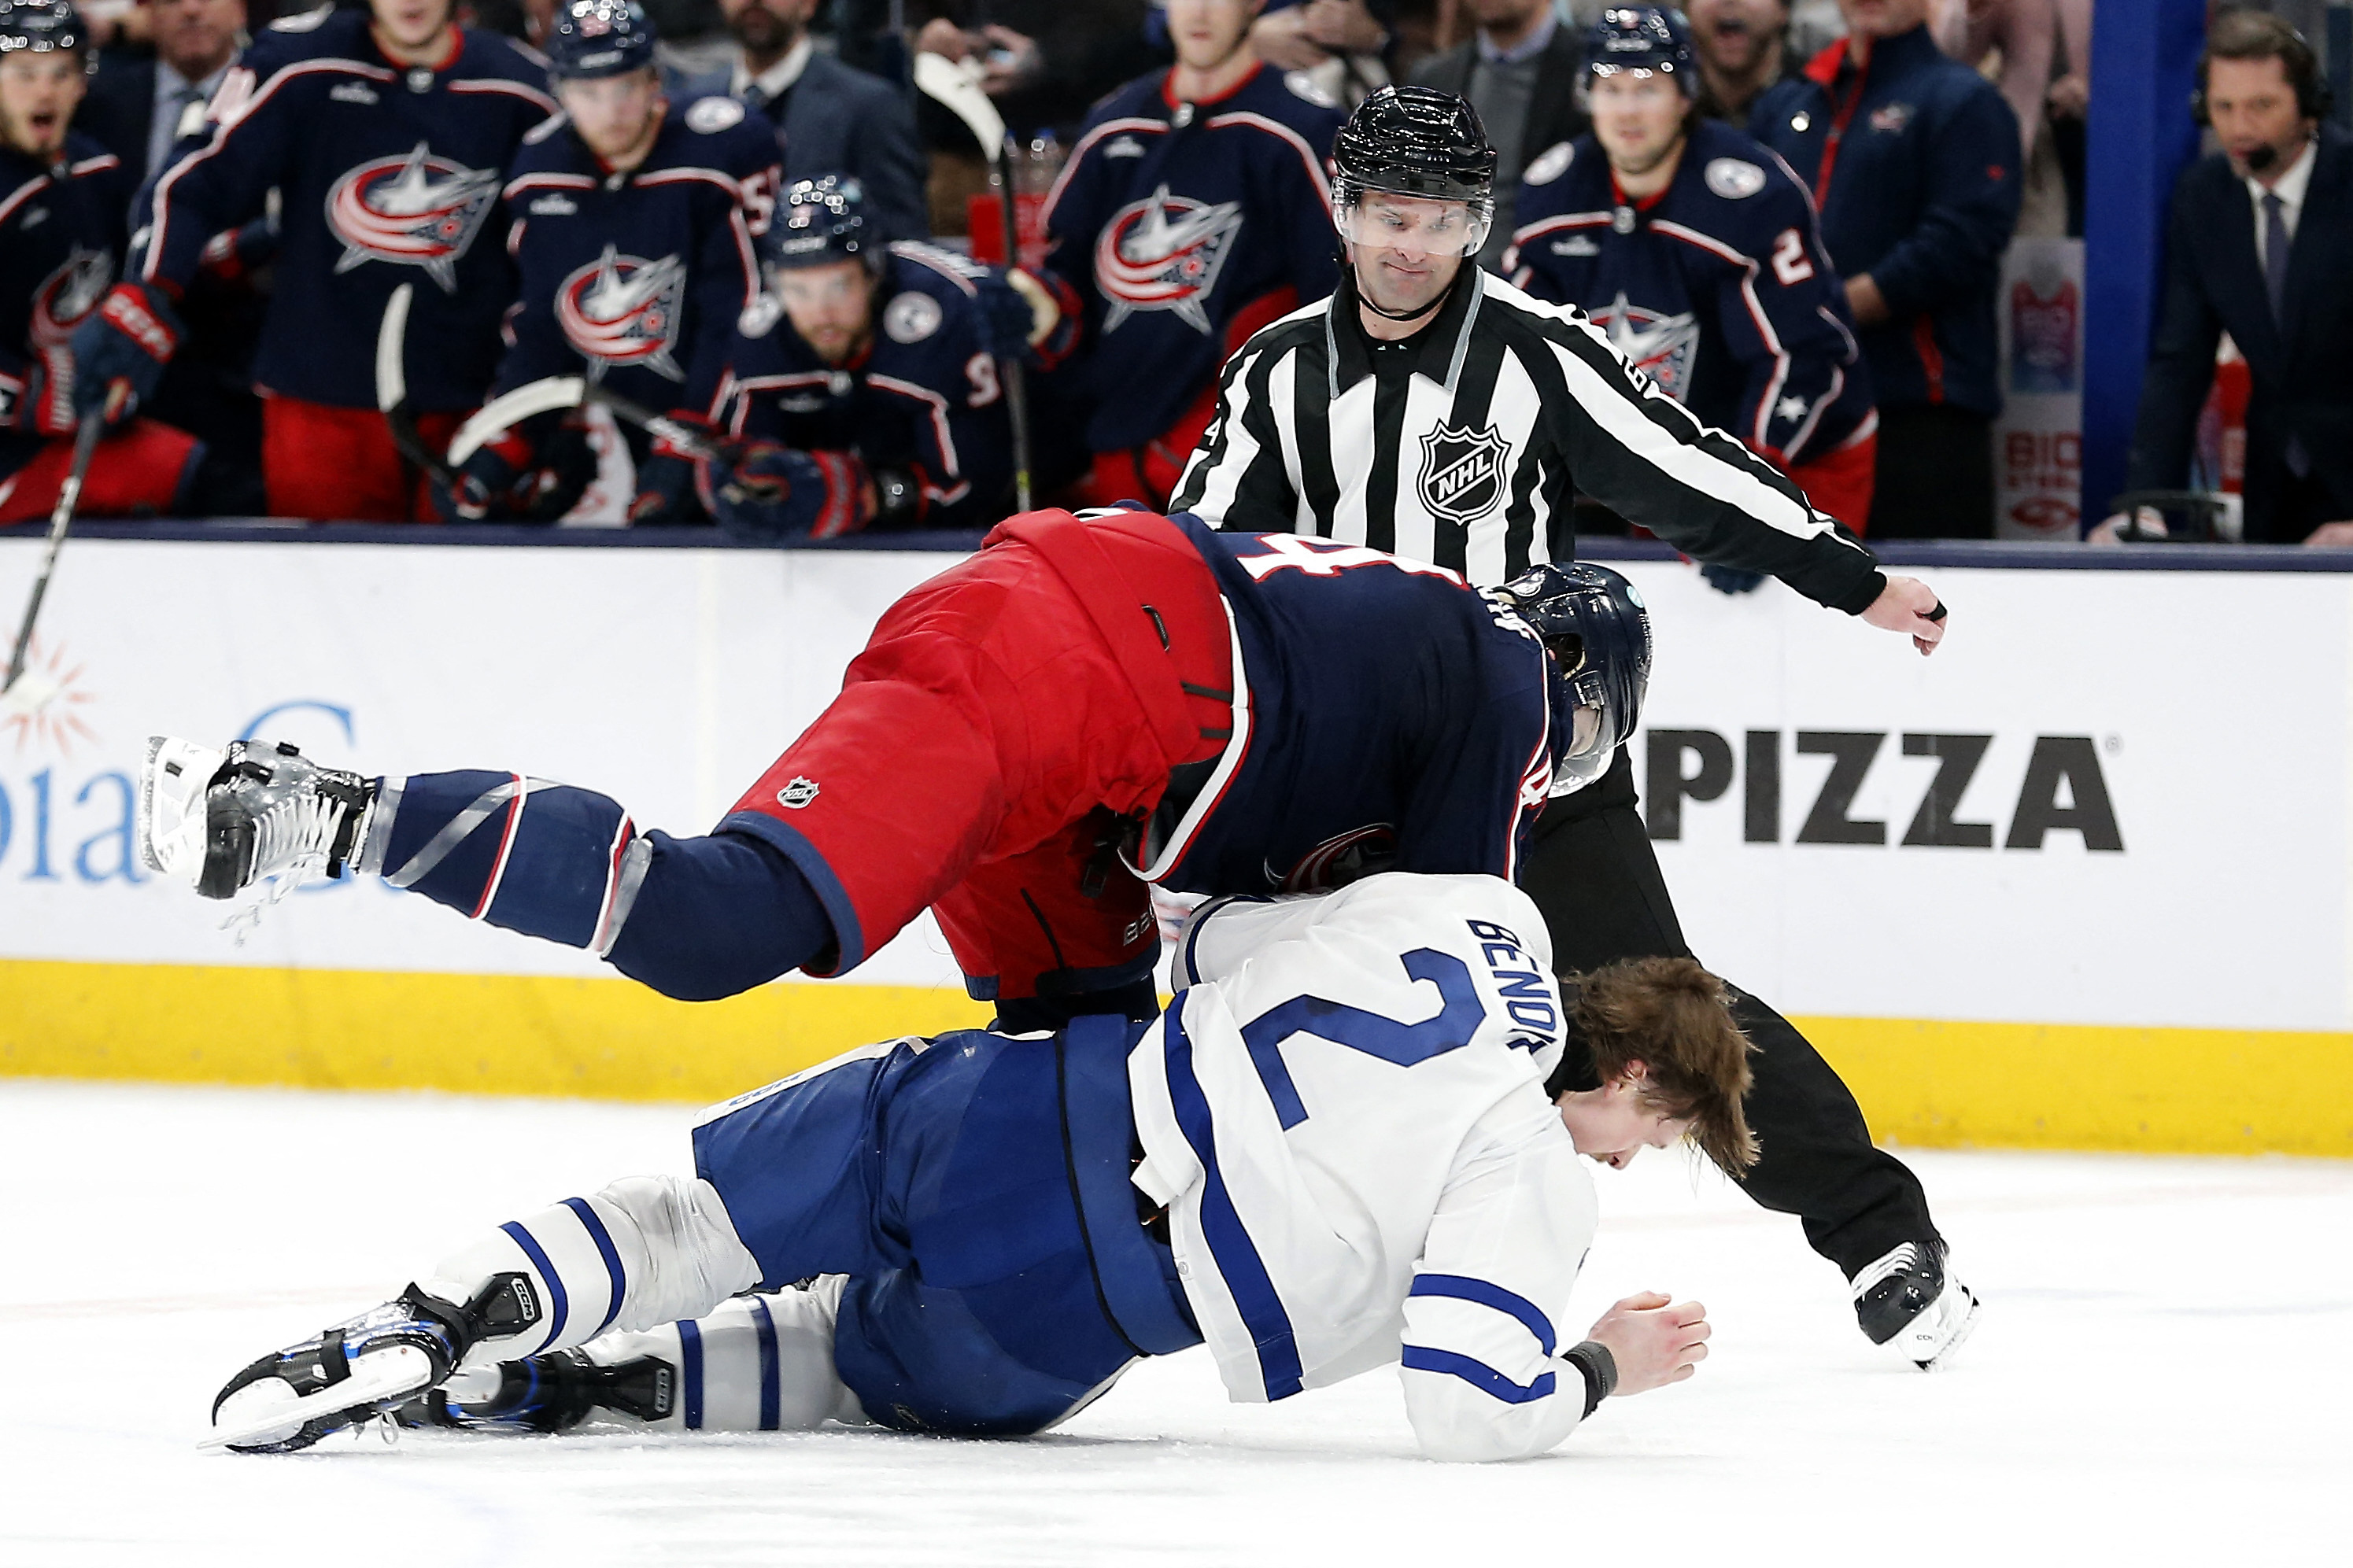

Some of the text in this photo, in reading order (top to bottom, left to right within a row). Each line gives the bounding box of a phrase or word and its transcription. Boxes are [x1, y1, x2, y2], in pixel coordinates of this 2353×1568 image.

[1438, 453, 1491, 501] NHL
[1646, 729, 2126, 851] PIZZA
[1239, 946, 1487, 1131] 2
[515, 1283, 534, 1315] CCM
